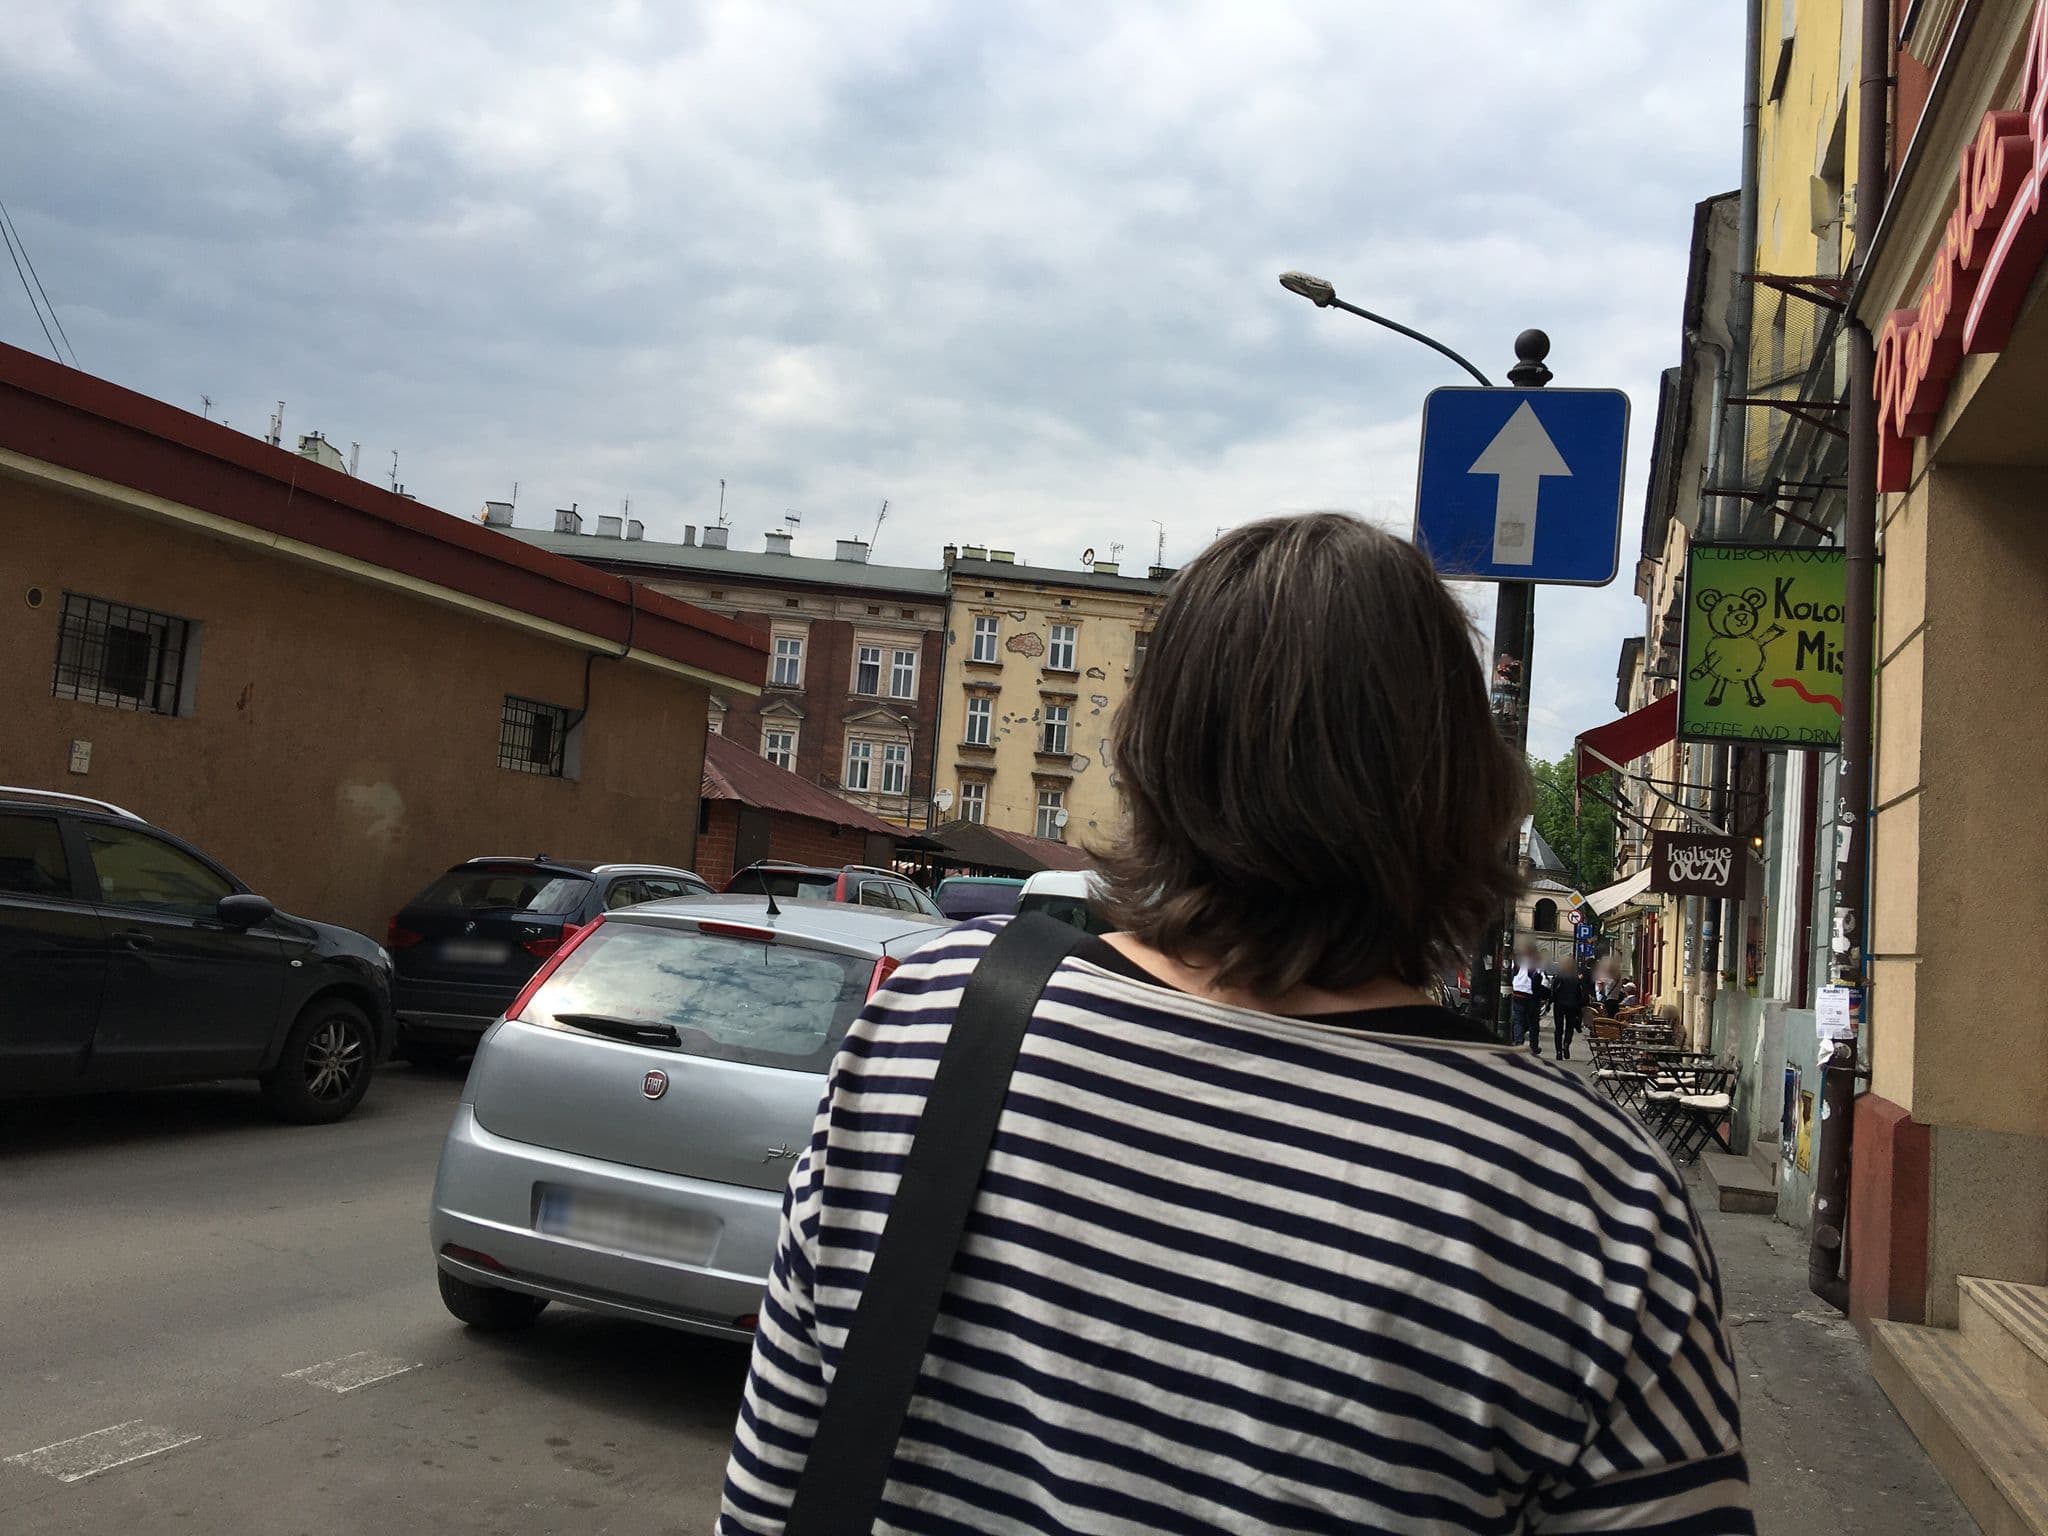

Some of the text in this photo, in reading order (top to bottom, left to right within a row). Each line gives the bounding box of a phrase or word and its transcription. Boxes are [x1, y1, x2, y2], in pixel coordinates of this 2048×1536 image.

[1750, 724, 1790, 740] AND
[1799, 726, 1842, 743] DRIN
[1668, 858, 1732, 887] oczy
[646, 1076, 663, 1092] FIAT
